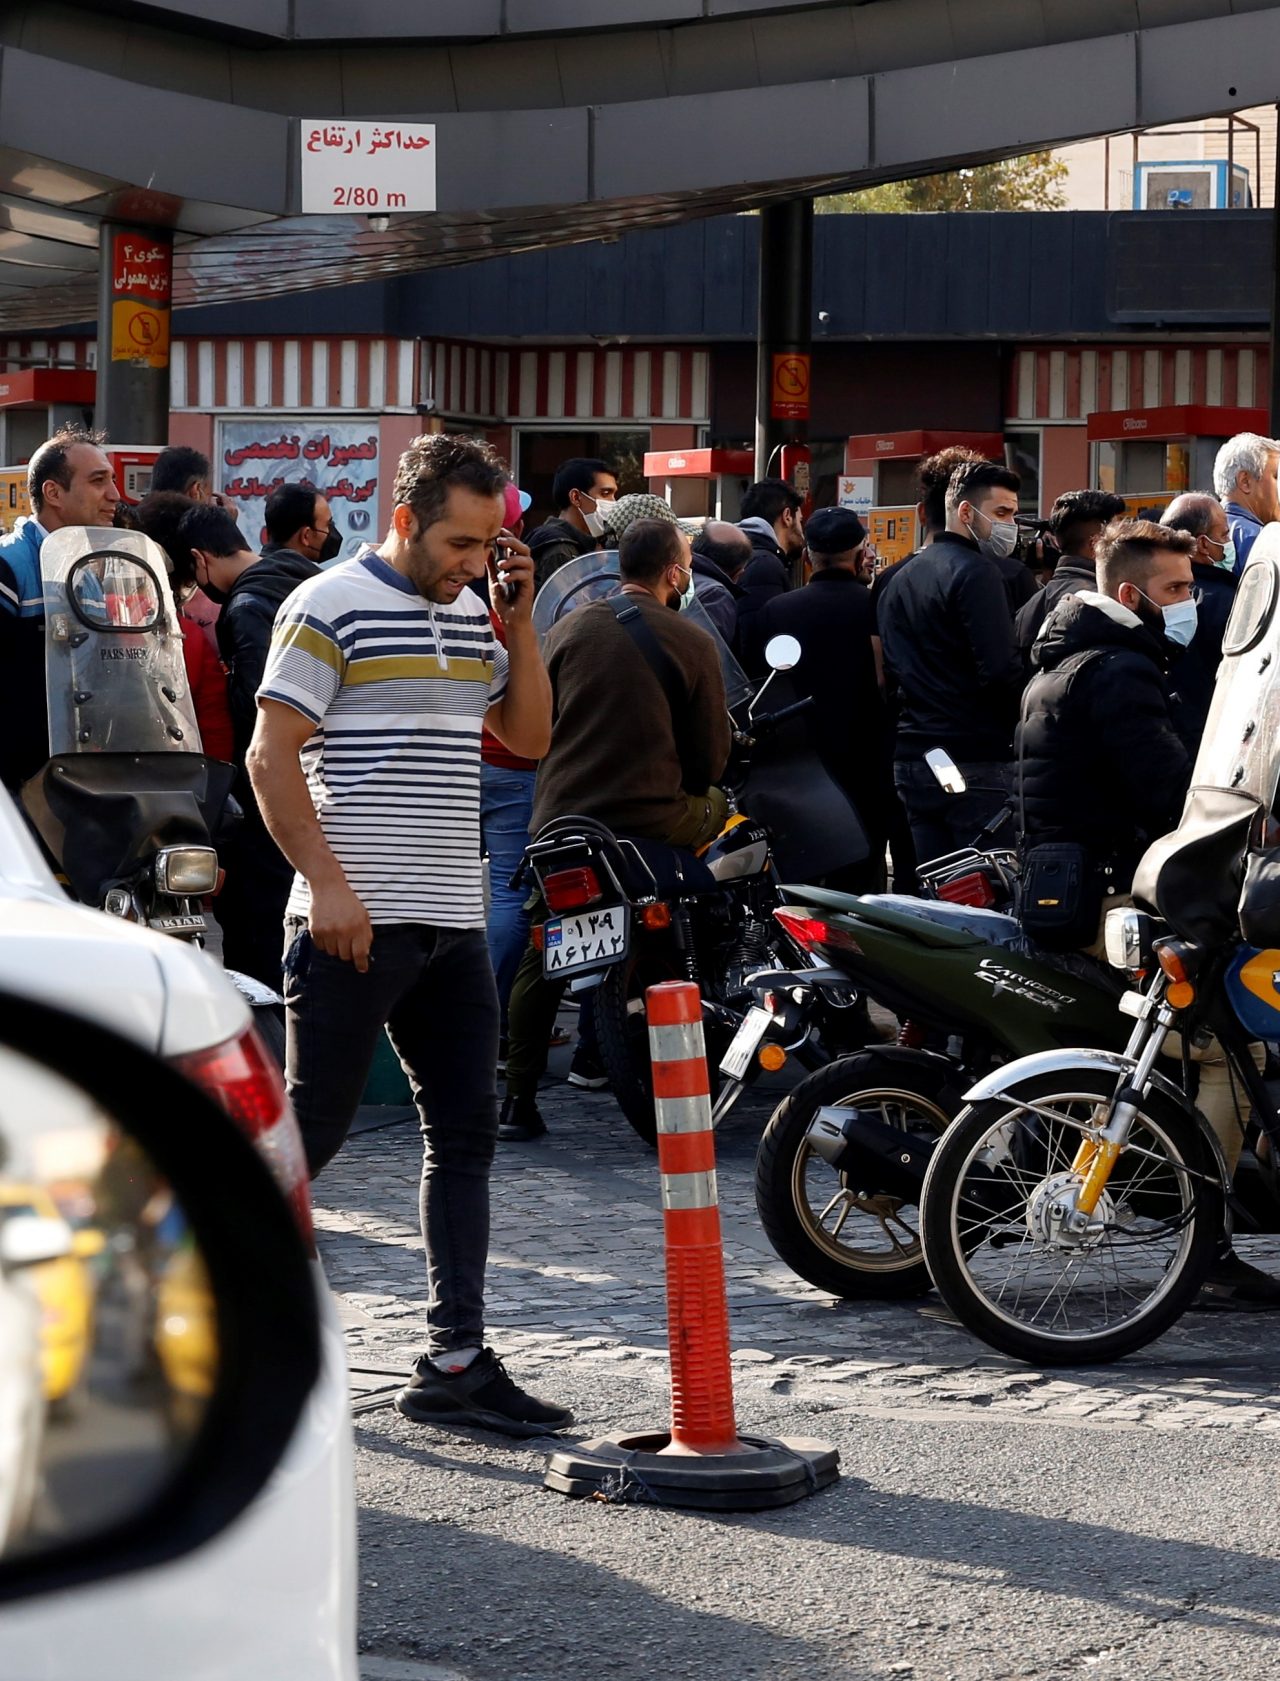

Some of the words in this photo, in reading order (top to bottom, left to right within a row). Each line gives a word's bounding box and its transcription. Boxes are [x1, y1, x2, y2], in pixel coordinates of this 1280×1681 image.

[306, 126, 361, 154] ارتفاع
[366, 128, 430, 155] حداکثر
[333, 187, 379, 206] 2/80
[387, 192, 406, 207] m
[114, 267, 148, 290] معمولی
[224, 435, 301, 467] تخصصی
[302, 435, 378, 467] تعمیرات
[101, 648, 124, 660] PARS
[162, 916, 203, 928] KIAN
[575, 912, 614, 938] ۱۳۹
[551, 934, 622, 969] ۸۶۲۸۲
